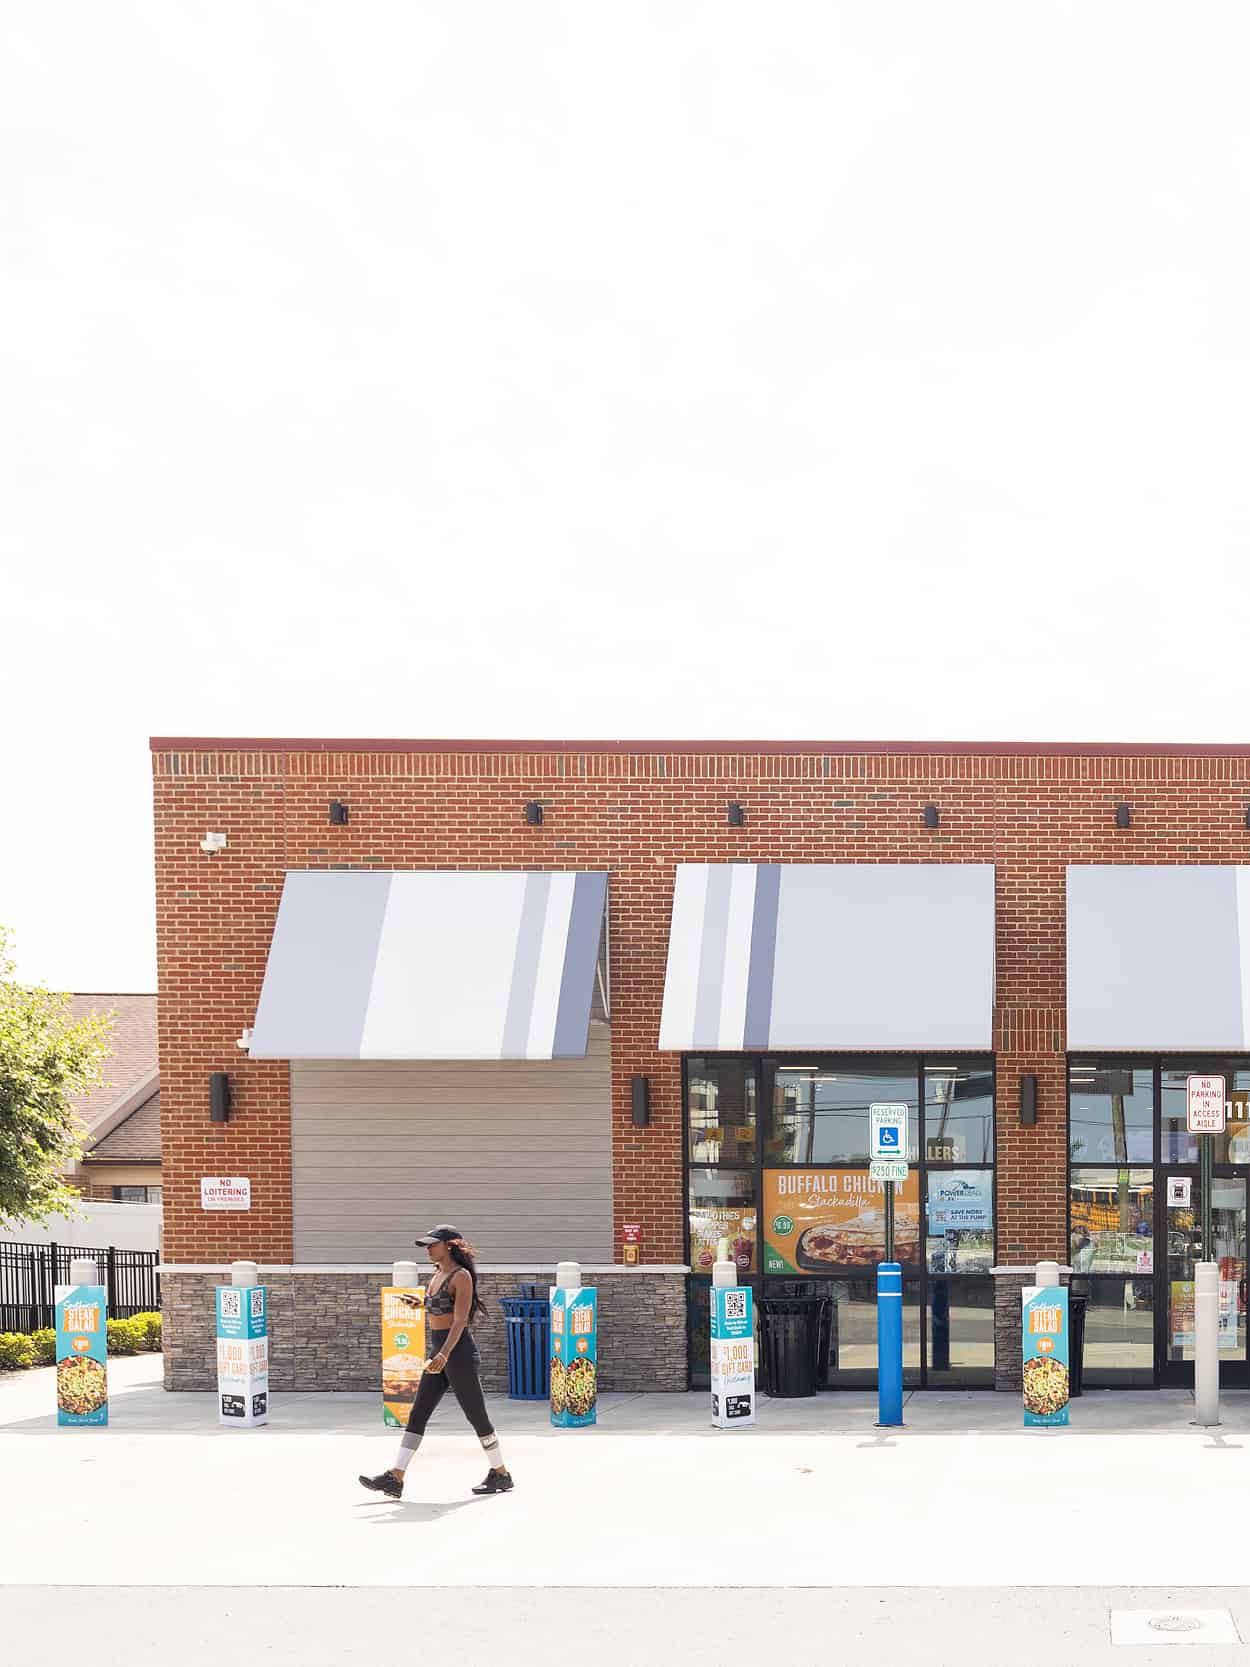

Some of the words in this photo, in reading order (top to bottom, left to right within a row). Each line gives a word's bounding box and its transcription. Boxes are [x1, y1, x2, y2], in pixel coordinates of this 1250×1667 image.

[1201, 1081, 1211, 1089] NO
[1191, 1090, 1222, 1098] PARKING
[873, 1108, 904, 1117] RESERVED
[1193, 1110, 1220, 1118] ACCESS
[876, 1117, 903, 1126] PARKING
[1196, 1120, 1217, 1128] AISLE
[872, 1165, 889, 1177] $250
[891, 1166, 907, 1177] FINE
[220, 1179, 231, 1187] NO
[778, 1175, 838, 1194] BUFFALO
[843, 1175, 904, 1195] CHICKN
[204, 1187, 247, 1196] LOITERING
[769, 1260, 784, 1269] NEW!
